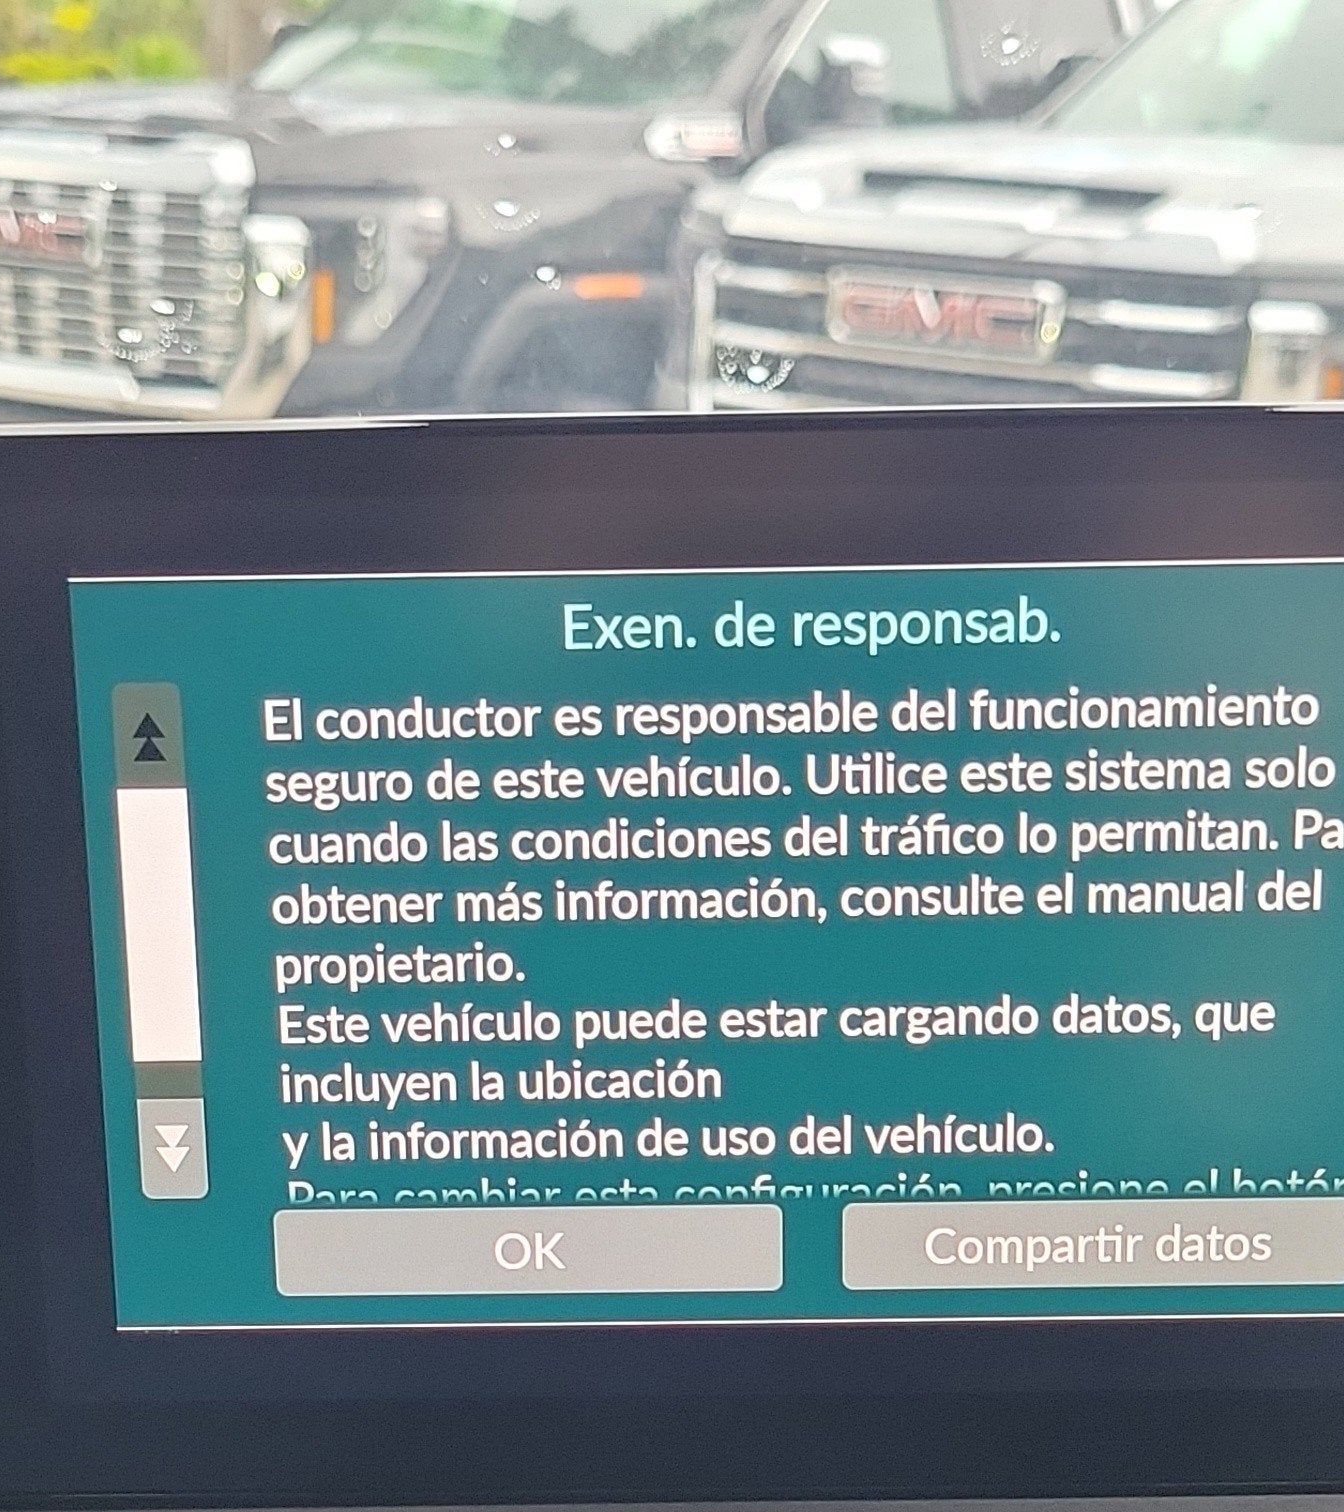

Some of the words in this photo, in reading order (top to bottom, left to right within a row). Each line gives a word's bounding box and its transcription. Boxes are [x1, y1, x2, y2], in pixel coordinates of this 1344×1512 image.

[842, 283, 1035, 345] GMC
[563, 603, 697, 650] Exen.
[714, 599, 775, 648] de
[793, 594, 1061, 656] responsab.
[264, 697, 303, 741] El
[315, 695, 542, 740] conductor
[553, 705, 603, 737] es
[615, 689, 879, 744] responsable
[890, 687, 957, 732] del
[969, 683, 1320, 731] funcionamiento
[265, 770, 413, 811] seguro
[426, 757, 481, 801] de
[492, 759, 585, 800] este
[595, 753, 792, 798] vehículo.
[806, 751, 948, 795] Utilice
[960, 752, 1053, 793] este
[1065, 748, 1231, 792] sistema
[1245, 744, 1336, 789] solo
[268, 820, 428, 864] cuando
[441, 819, 499, 862] las
[510, 816, 772, 861] condiciones
[783, 813, 848, 857] del
[860, 812, 1005, 856] tráfico
[1018, 811, 1058, 854] lo
[1071, 808, 1279, 862] permitan.
[271, 882, 444, 925] obtener
[456, 881, 543, 922] más
[555, 876, 827, 924] información,
[840, 873, 1025, 917] consulte
[1036, 871, 1074, 915] el
[1087, 868, 1245, 914] manual
[1257, 868, 1323, 912] del
[275, 941, 526, 994] propietario.
[279, 1004, 370, 1044] Este
[380, 1000, 561, 1043] vehículo
[574, 998, 708, 1050] puede
[719, 999, 828, 1039] estar
[838, 993, 1040, 1045] cargando
[1052, 992, 1182, 1040] datos,
[1194, 1001, 1276, 1041] que
[280, 1061, 457, 1111] incluyen
[470, 1060, 505, 1101] la
[518, 1058, 722, 1100] ubicación
[282, 1132, 309, 1170] y
[321, 1120, 356, 1161] la
[368, 1118, 624, 1161] información
[636, 1116, 689, 1158] de
[702, 1126, 776, 1157] uso
[789, 1114, 852, 1156] del
[863, 1111, 1055, 1155] vehículo.
[287, 1179, 379, 1204] Para
[394, 1176, 561, 1203] cambiar
[575, 1178, 658, 1201] esta
[674, 1173, 964, 1200] configuración
[492, 1230, 567, 1272] OK
[924, 1222, 1144, 1272] Compartir
[1154, 1222, 1274, 1263] datos
